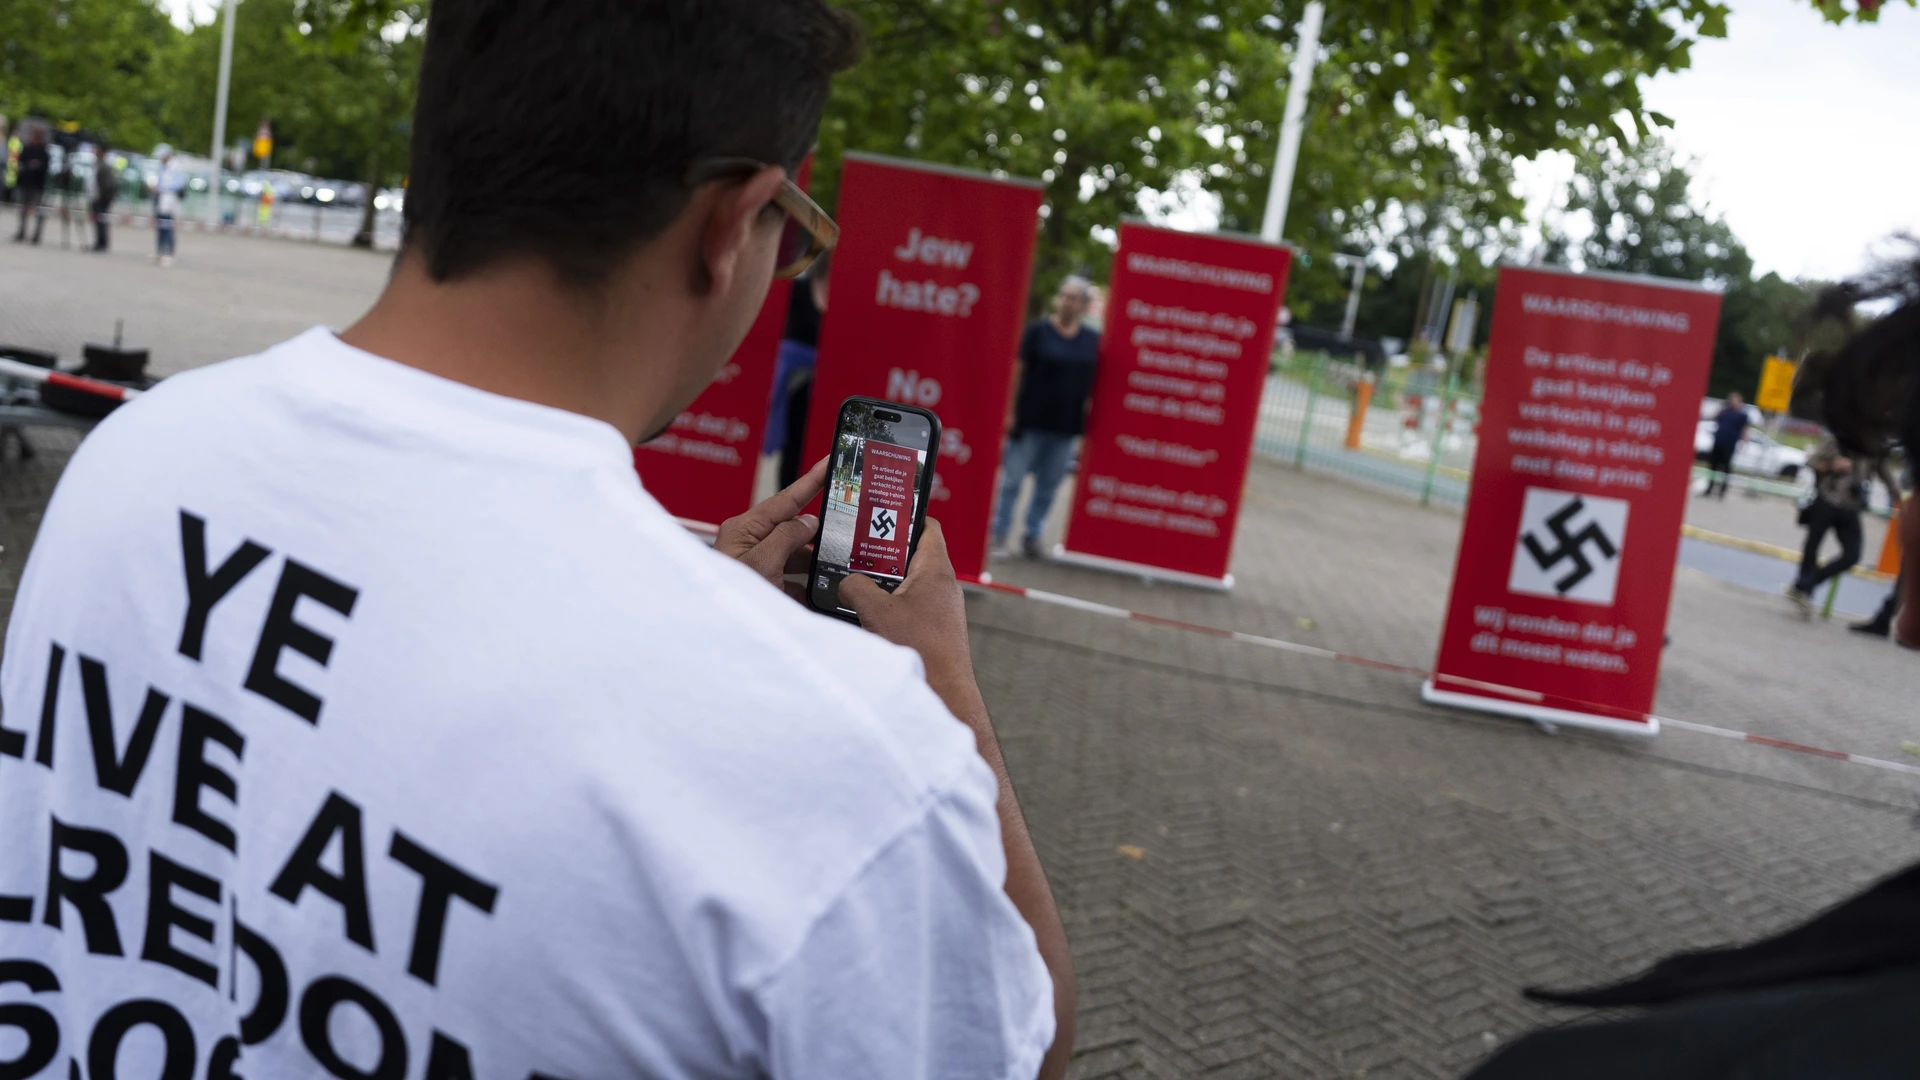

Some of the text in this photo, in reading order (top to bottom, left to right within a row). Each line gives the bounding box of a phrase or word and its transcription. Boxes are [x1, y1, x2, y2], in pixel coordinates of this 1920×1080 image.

[894, 226, 974, 271] Jew
[876, 268, 981, 319] hate?
[1522, 292, 1690, 333] WAARSCHUWING
[1523, 345, 1672, 388] De artiest die je
[886, 367, 942, 408] No
[1531, 377, 1656, 410] gaat bekijken
[1518, 401, 1662, 439] verkocht in zijn
[871, 449, 911, 461] WAARSCHUWING
[1507, 426, 1593, 455] webshop
[871, 481, 891, 489] verkocht
[885, 475, 903, 483] bekijken
[1510, 454, 1550, 474] met
[1553, 459, 1596, 480] deze
[889, 492, 905, 500] t-shirts
[868, 544, 886, 552] vonden
[177, 508, 360, 728] YE
[1474, 605, 1637, 650] Wij vonden dat je
[1470, 631, 1629, 674] dit moest weten.
[0, 640, 501, 988] IVE AT
